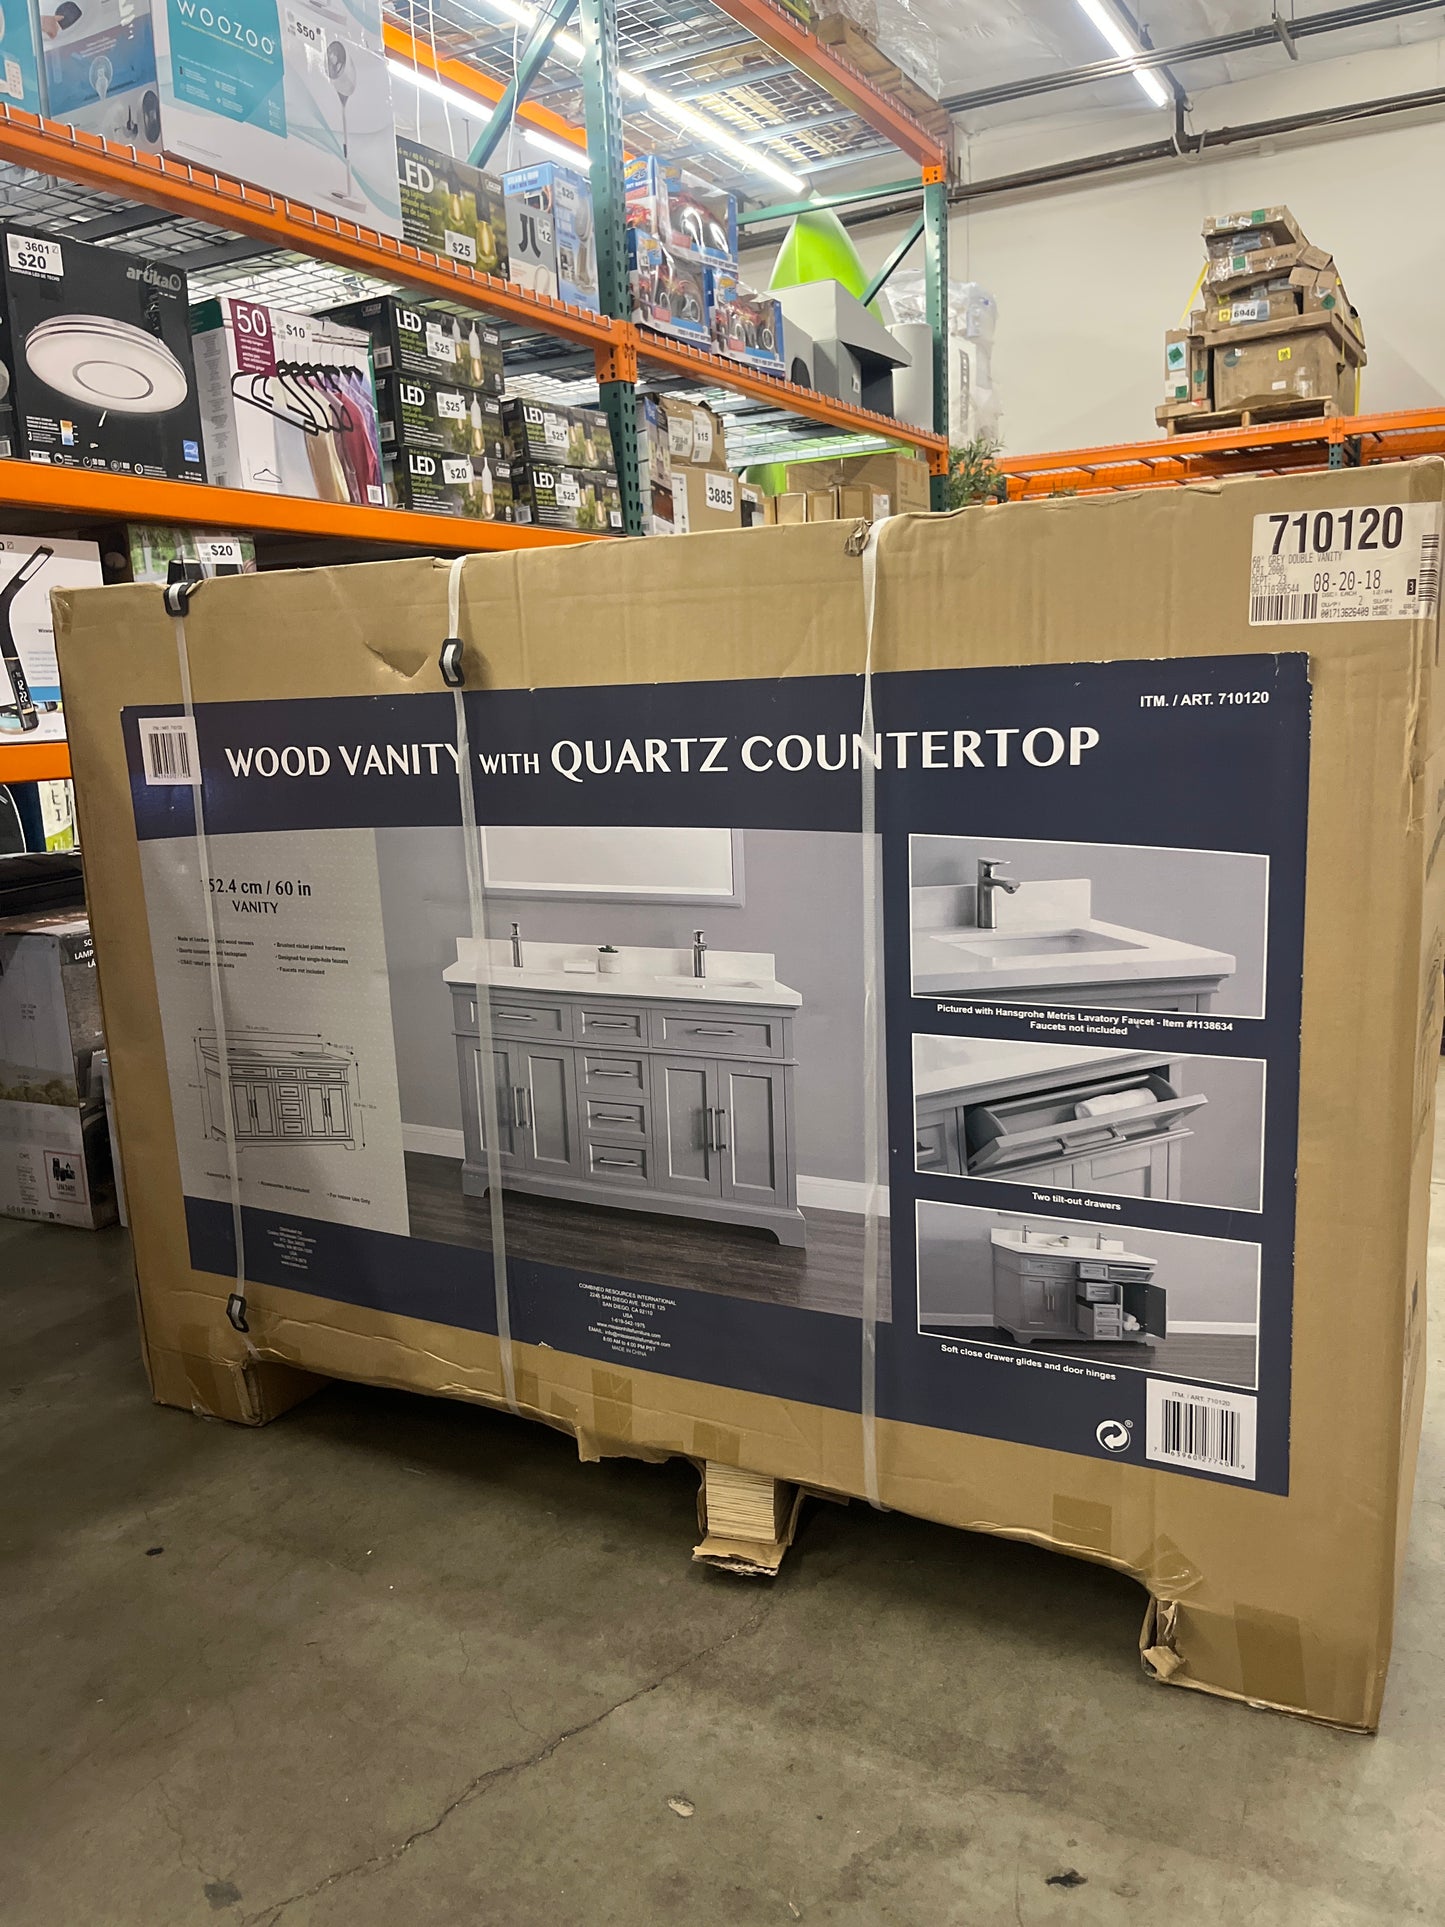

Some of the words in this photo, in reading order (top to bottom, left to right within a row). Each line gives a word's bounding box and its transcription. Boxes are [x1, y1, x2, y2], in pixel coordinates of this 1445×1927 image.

[177, 0, 273, 55] WOOZOO
[296, 22, 315, 41] $50
[562, 187, 575, 200] $20
[25, 241, 50, 255] 3601
[452, 242, 471, 257] $25
[17, 252, 47, 269] $20
[236, 305, 267, 337] 50
[396, 308, 422, 333] LED
[286, 324, 305, 339] $10
[434, 341, 450, 355] $25
[400, 383, 426, 407] LED
[446, 401, 460, 412] $25
[523, 406, 544, 425] LED
[551, 430, 564, 441] $25
[408, 454, 436, 476] LED
[450, 468, 467, 479] $20
[533, 471, 555, 489] LED
[563, 491, 576, 501] $25
[708, 487, 733, 506] 3885
[1269, 506, 1404, 555] 710120
[210, 544, 234, 557] $20
[1288, 552, 1313, 564] DOUBLE
[1317, 550, 1343, 563] VANITY
[1313, 569, 1382, 593] 08-20-18
[1140, 695, 1169, 708] ITM.
[1172, 694, 1178, 707] /
[1180, 693, 1214, 706] ART.
[1218, 691, 1270, 704] 710120
[224, 746, 332, 777] WOOD
[337, 743, 469, 776] VANITY
[479, 752, 540, 775] WITH
[550, 738, 730, 783] QUARTZ
[740, 726, 1101, 772] COUNTERTOP
[200, 878, 237, 894] 52.4
[240, 882, 263, 895] cm
[266, 880, 271, 896] /
[275, 880, 294, 896] 60
[297, 879, 312, 897] in
[232, 900, 279, 914] VANITY
[937, 1003, 973, 1014] Pictured
[974, 1007, 994, 1016] with
[995, 1008, 1045, 1020] Hansgrohe
[1046, 1011, 1076, 1021] Metris
[1078, 1013, 1119, 1025] Lavatory
[1121, 1016, 1155, 1027] Faucet
[1162, 1018, 1185, 1029] Item
[1186, 1019, 1233, 1032] #1138634
[1030, 1021, 1067, 1031] Faucets
[1068, 1024, 1084, 1032] not
[1086, 1025, 1128, 1036] included
[1032, 1192, 1050, 1201] Two
[1052, 1195, 1082, 1206] tilt-out
[1084, 1199, 1122, 1211] drawers
[578, 1282, 605, 1292] COMBINED
[604, 1287, 637, 1299] RESOURCES
[636, 1294, 677, 1306] INTERNATIONAL
[612, 1296, 629, 1304] DIEGO
[641, 1302, 656, 1310] SUITE
[611, 1344, 625, 1352] MADE
[631, 1349, 647, 1357] CHINA
[940, 1344, 958, 1354] Soft
[960, 1348, 983, 1358] close
[984, 1351, 1014, 1363] drawer
[1016, 1357, 1042, 1368] glides
[1044, 1362, 1061, 1371] and
[1063, 1365, 1084, 1375] door
[1086, 1369, 1116, 1381] hinges
